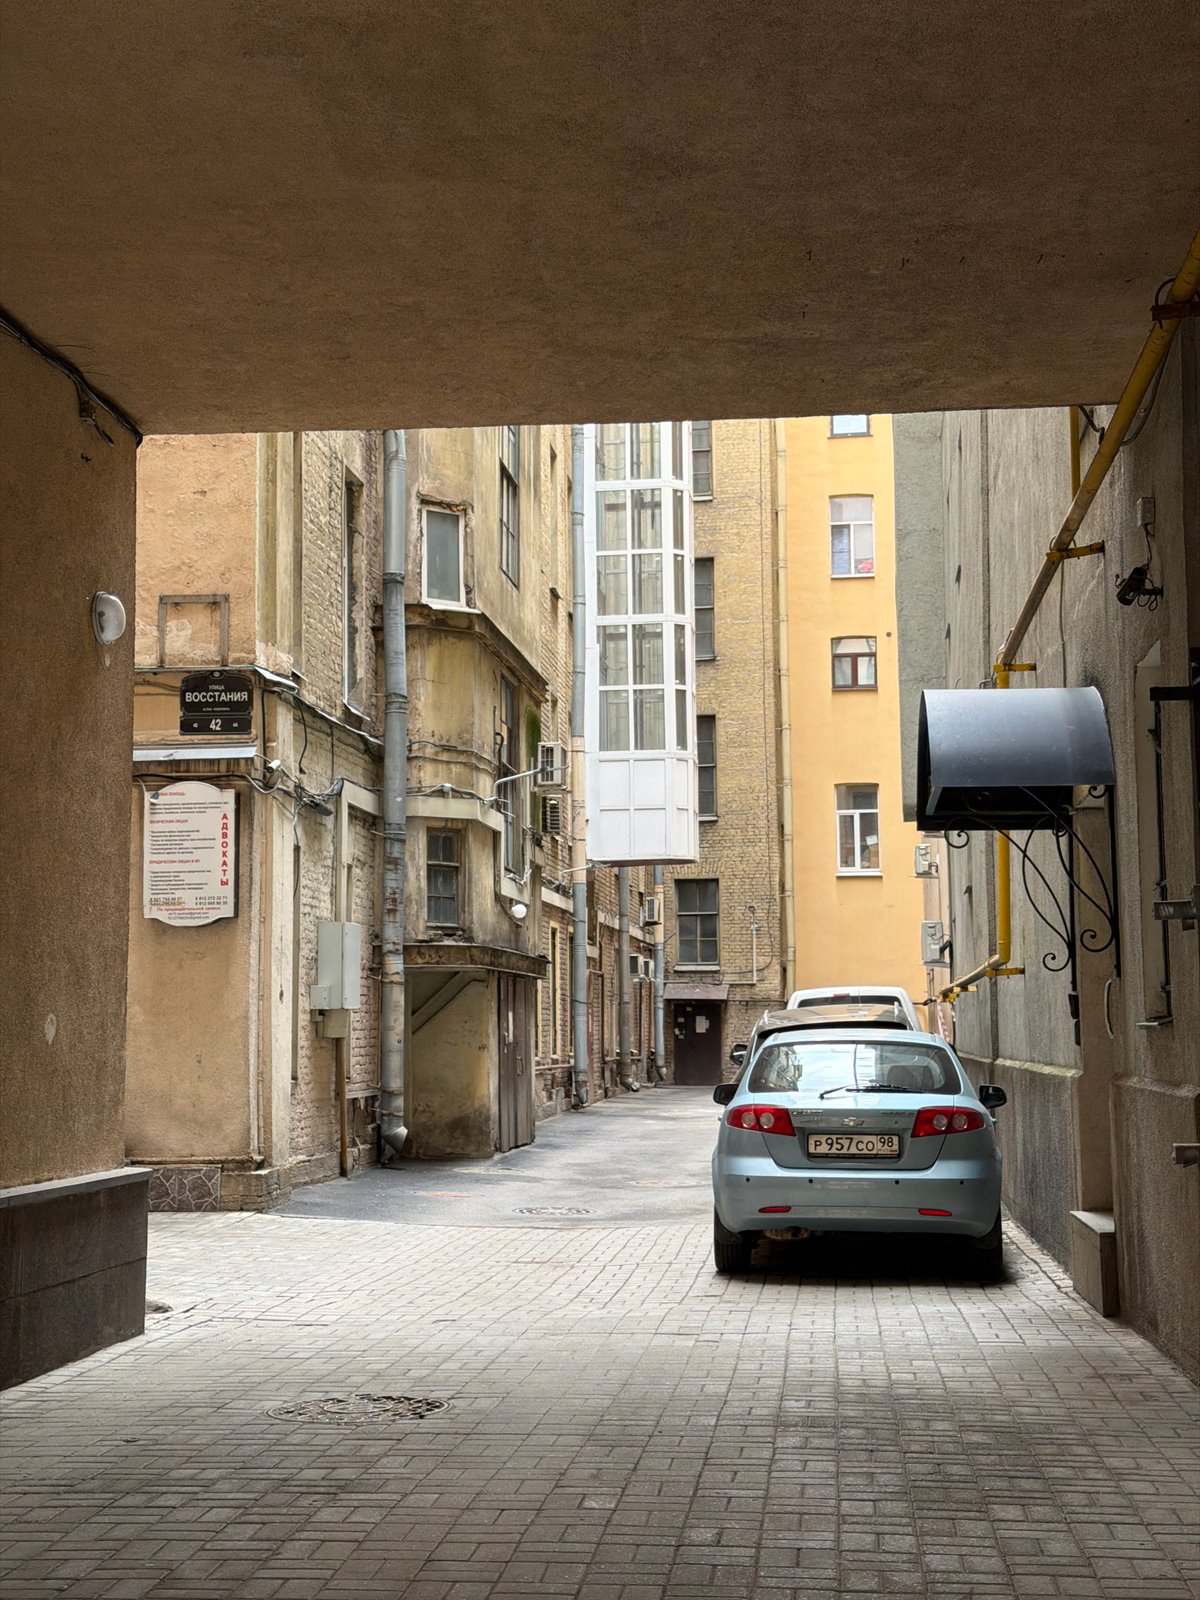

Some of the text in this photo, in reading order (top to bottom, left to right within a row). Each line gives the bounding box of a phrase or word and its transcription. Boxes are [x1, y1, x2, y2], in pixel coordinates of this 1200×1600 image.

[185, 691, 248, 702] ВОССТАНИЯ
[209, 718, 222, 731] 42
[220, 813, 229, 886] АДВОКАТЫ
